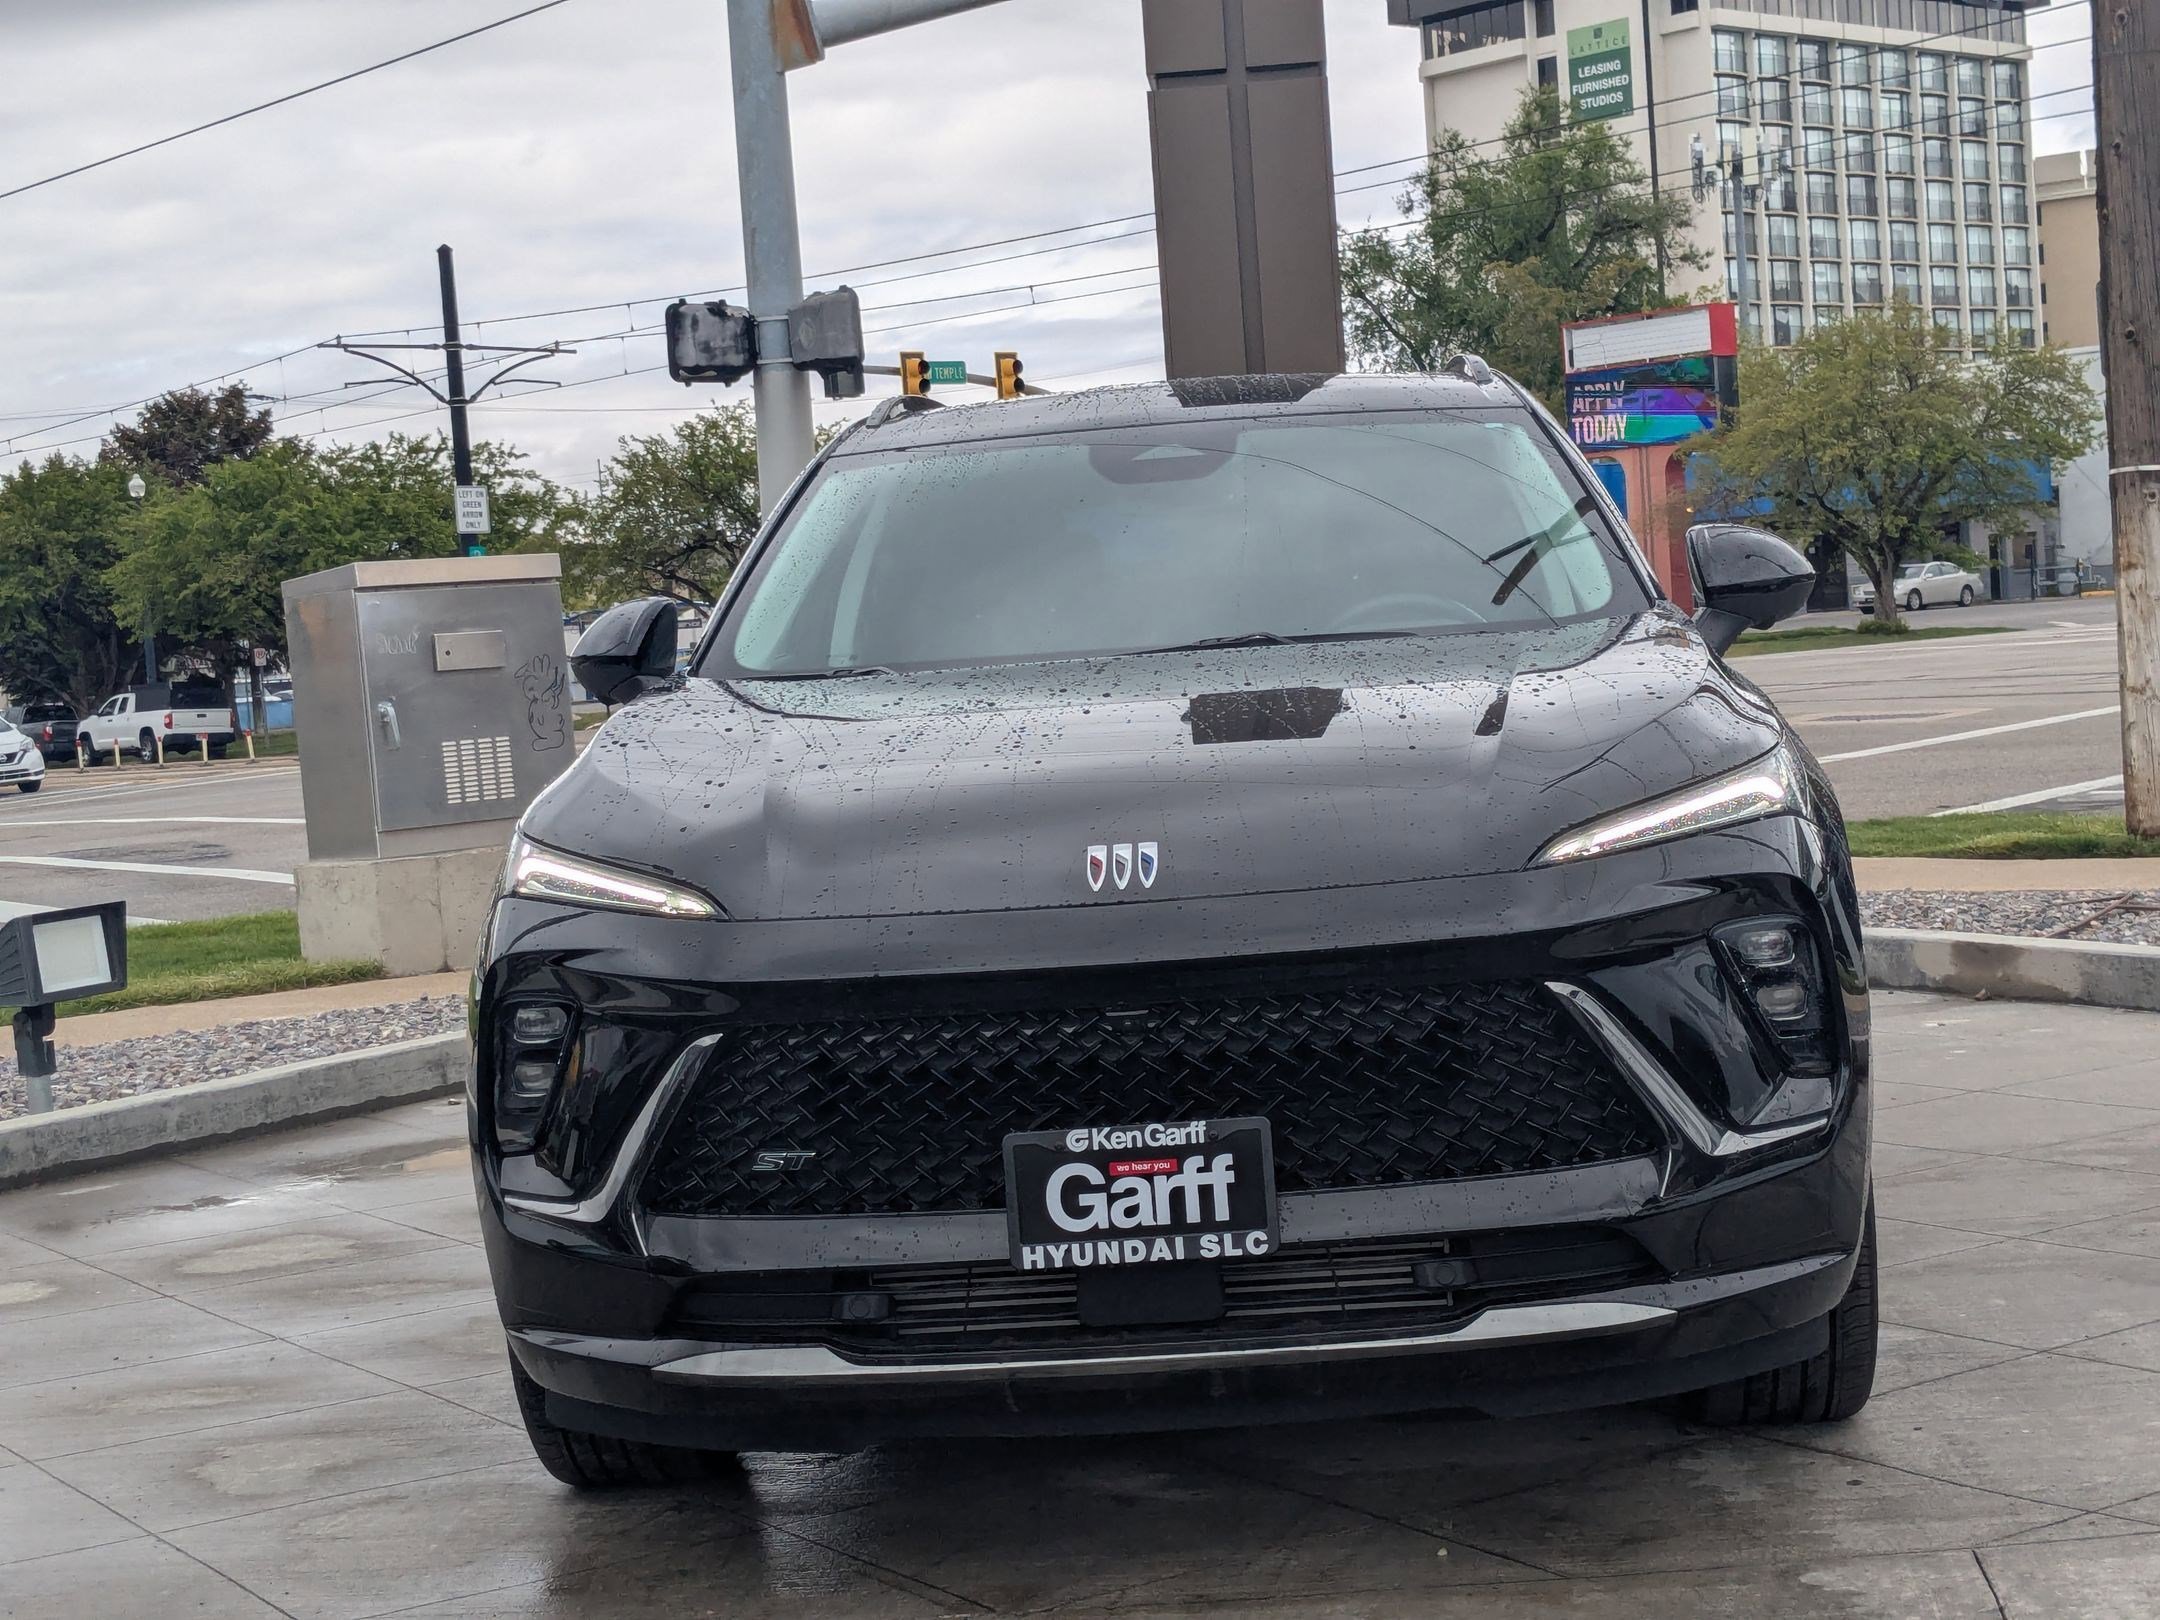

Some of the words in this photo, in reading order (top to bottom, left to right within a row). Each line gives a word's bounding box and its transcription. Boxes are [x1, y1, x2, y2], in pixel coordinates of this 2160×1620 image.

[1571, 35, 1628, 56] LATTICE
[1578, 60, 1621, 78] LEASING
[1572, 75, 1629, 96] FURNISHED
[1580, 91, 1623, 110] STUDIOS
[935, 367, 964, 379] TEMPLE
[1573, 380, 1625, 413] APPLY
[1572, 413, 1627, 445] TODAY
[458, 490, 472, 498] LEFT
[751, 1152, 817, 1171] ST
[1116, 1164, 1130, 1172] we
[1131, 1162, 1153, 1171] hear
[1153, 1161, 1171, 1172] you
[1046, 1153, 1235, 1233] Garff
[1021, 1236, 1185, 1270] HYUNDAI
[1199, 1230, 1270, 1259] SLC
